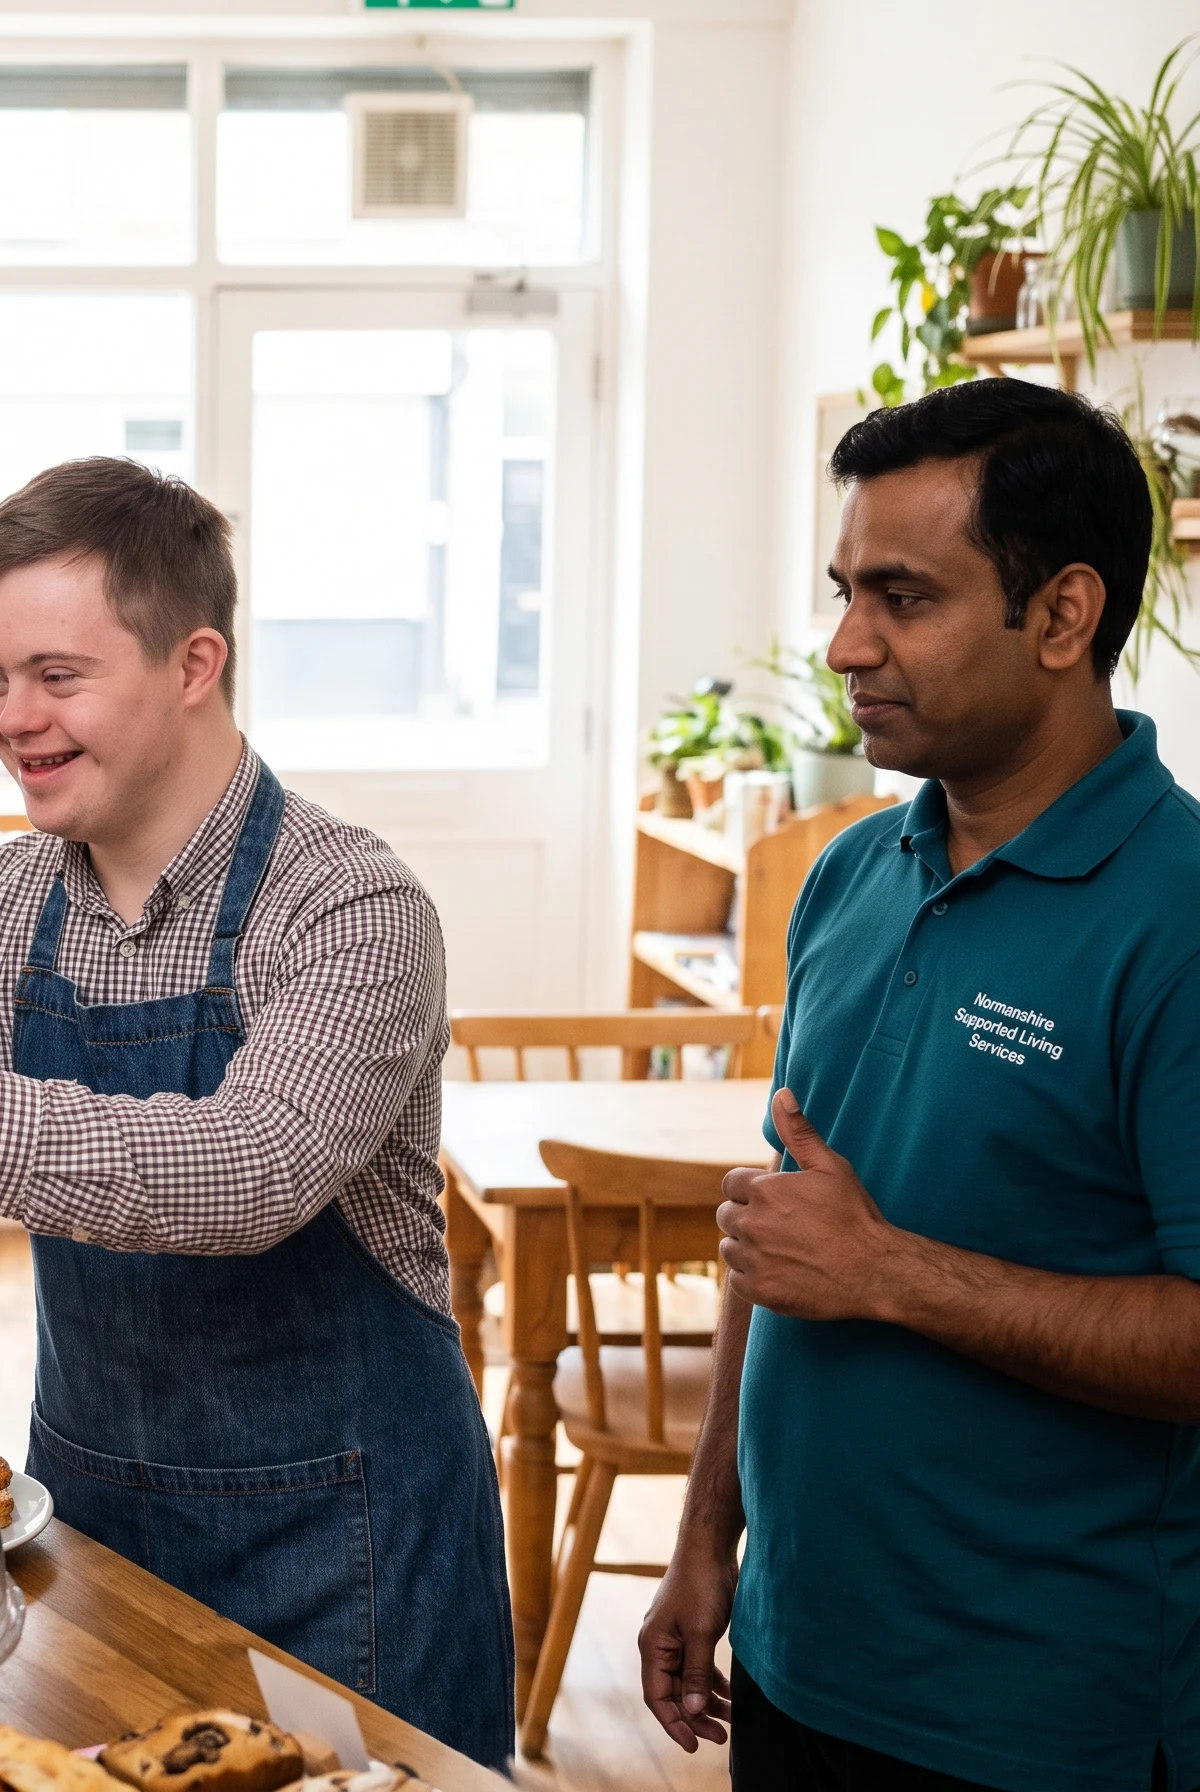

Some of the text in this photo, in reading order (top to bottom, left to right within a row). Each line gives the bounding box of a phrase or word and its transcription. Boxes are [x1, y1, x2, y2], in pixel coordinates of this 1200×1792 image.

[973, 991, 1055, 1032] Normanshire
[968, 1033, 1026, 1065] Services
[1018, 1029, 1064, 1061] Living
